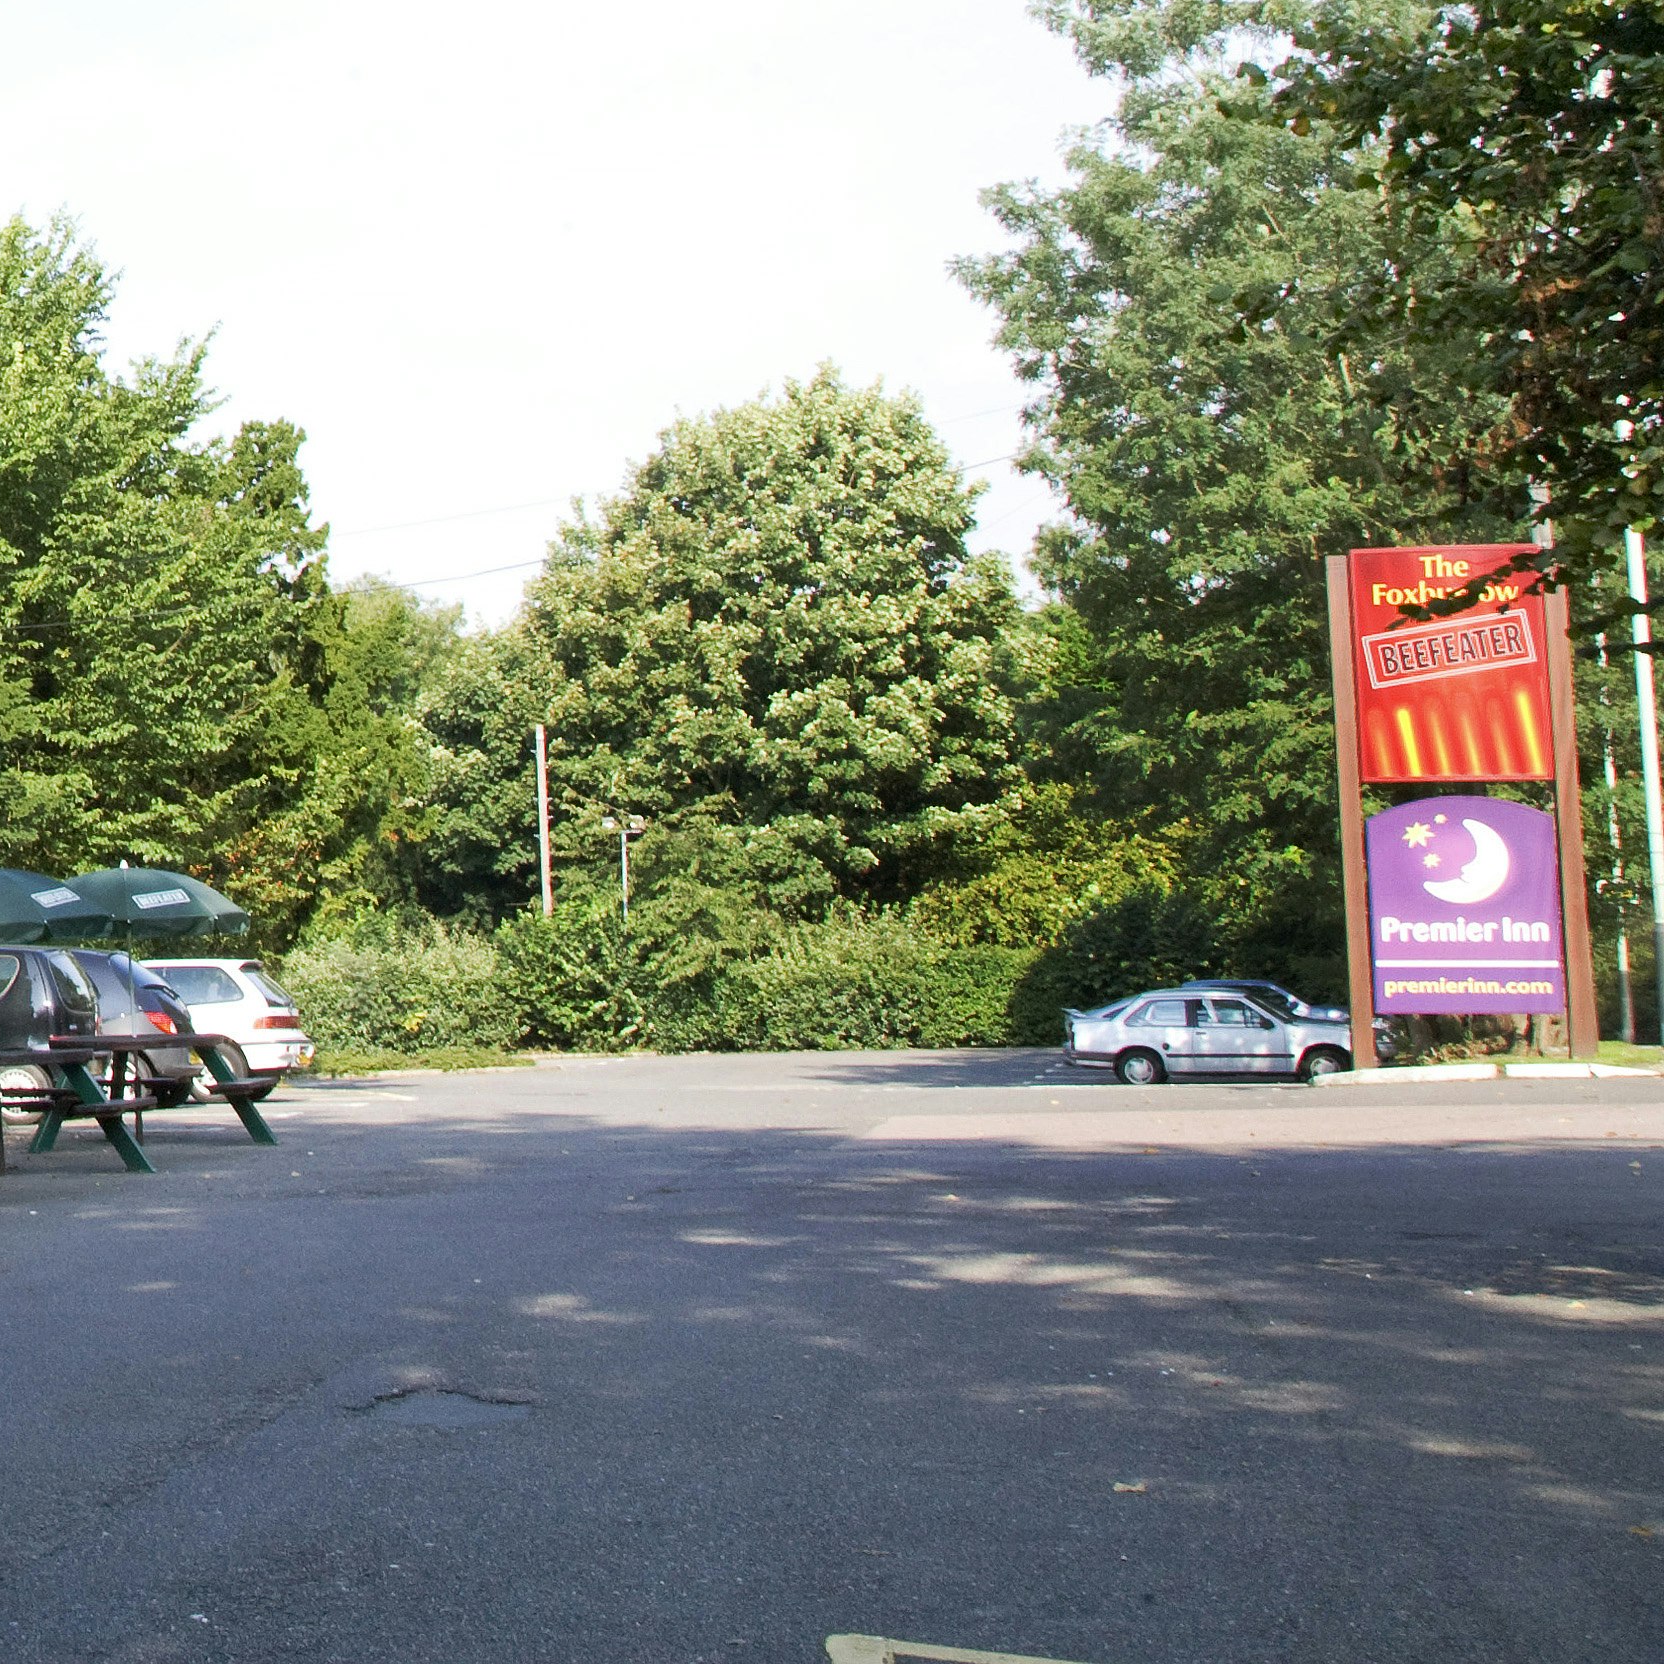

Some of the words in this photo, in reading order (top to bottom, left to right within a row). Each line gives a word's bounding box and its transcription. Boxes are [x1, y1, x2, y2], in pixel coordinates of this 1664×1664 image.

[1418, 553, 1470, 578] The
[1372, 580, 1519, 606] Foxbow
[1378, 623, 1524, 676] BEEFEATER
[1380, 916, 1499, 943] Premier
[1501, 916, 1551, 943] Inn
[1383, 976, 1554, 999] premierinn.com
